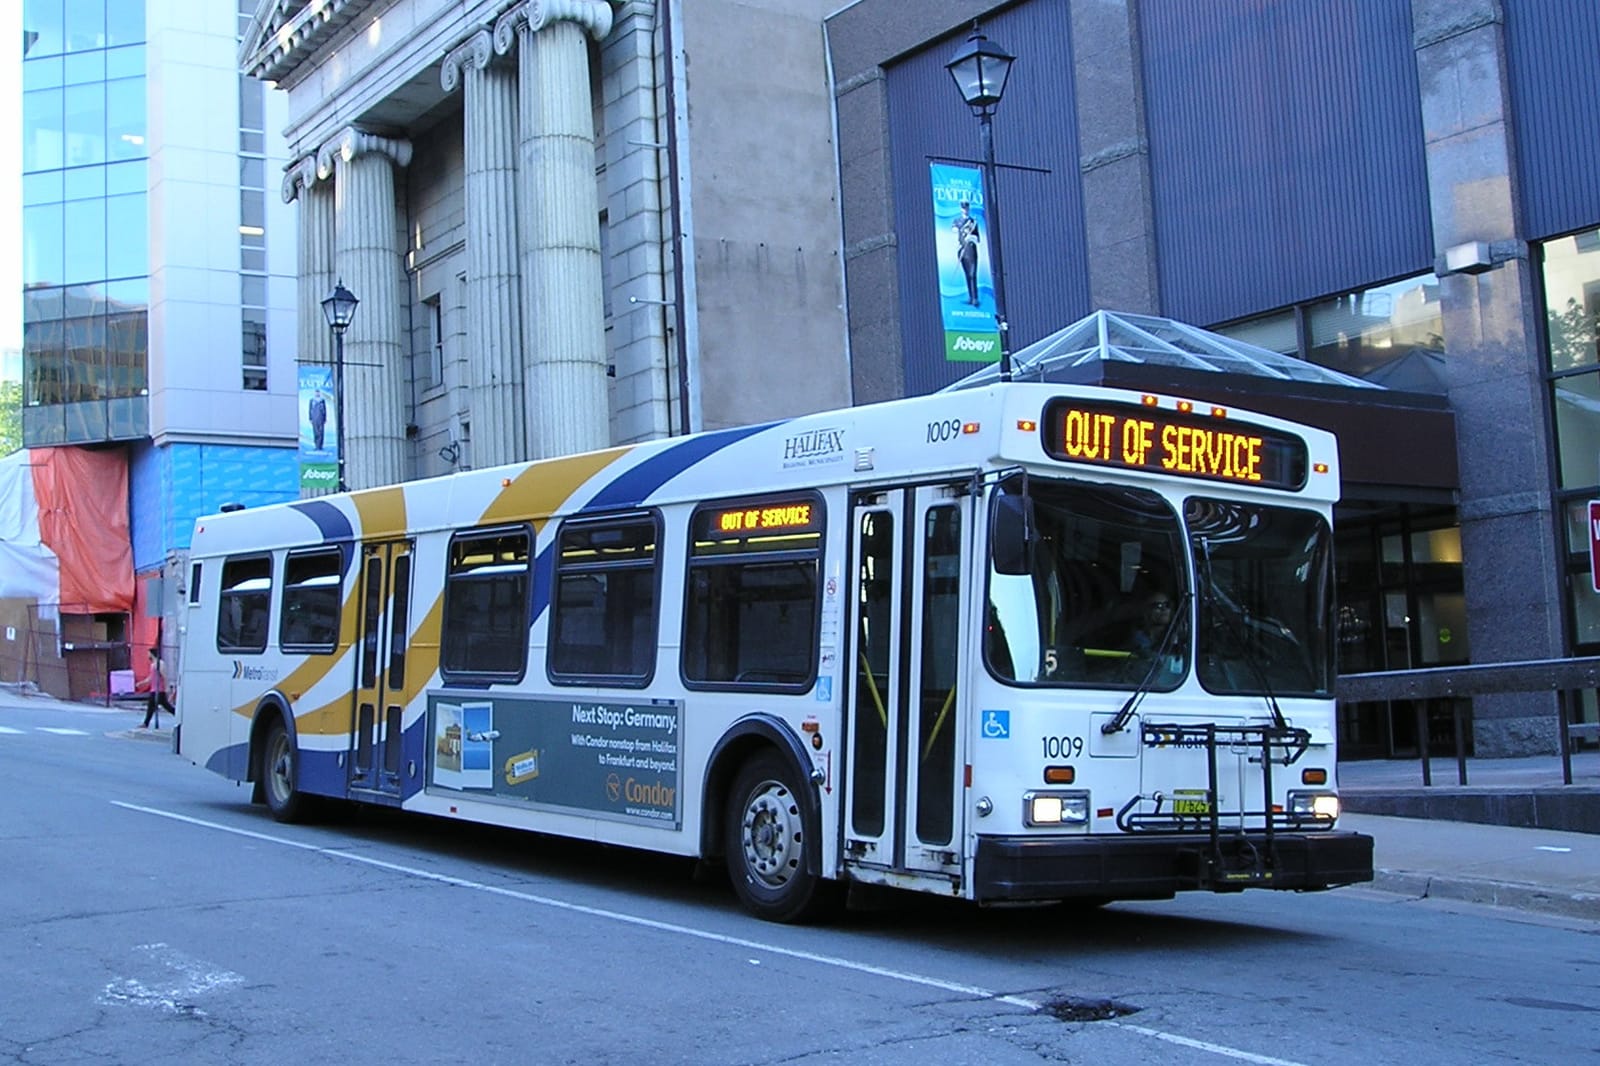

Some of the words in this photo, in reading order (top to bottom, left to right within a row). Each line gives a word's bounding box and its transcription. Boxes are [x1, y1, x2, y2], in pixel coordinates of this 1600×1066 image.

[953, 335, 995, 353] Sobeys
[926, 418, 961, 444] 1009
[1065, 409, 1115, 460] OUT
[1122, 418, 1155, 465] OF
[1161, 424, 1263, 481] SERVICE
[721, 511, 744, 530] OUT
[744, 510, 760, 529] OF
[761, 505, 810, 528] SERVICE
[1045, 649, 1058, 673] 5
[572, 704, 596, 724] Next
[597, 705, 624, 730] Stop:
[625, 707, 677, 734] Germany.
[571, 733, 585, 746] With
[585, 735, 608, 748] Condor
[609, 739, 634, 753] nonstop
[635, 739, 651, 752] from
[651, 740, 676, 754] Halifax
[1042, 736, 1084, 759] 1009
[598, 753, 605, 765] to
[606, 753, 635, 767] Frankfurt
[636, 757, 648, 769] and
[624, 777, 676, 807] Condor
